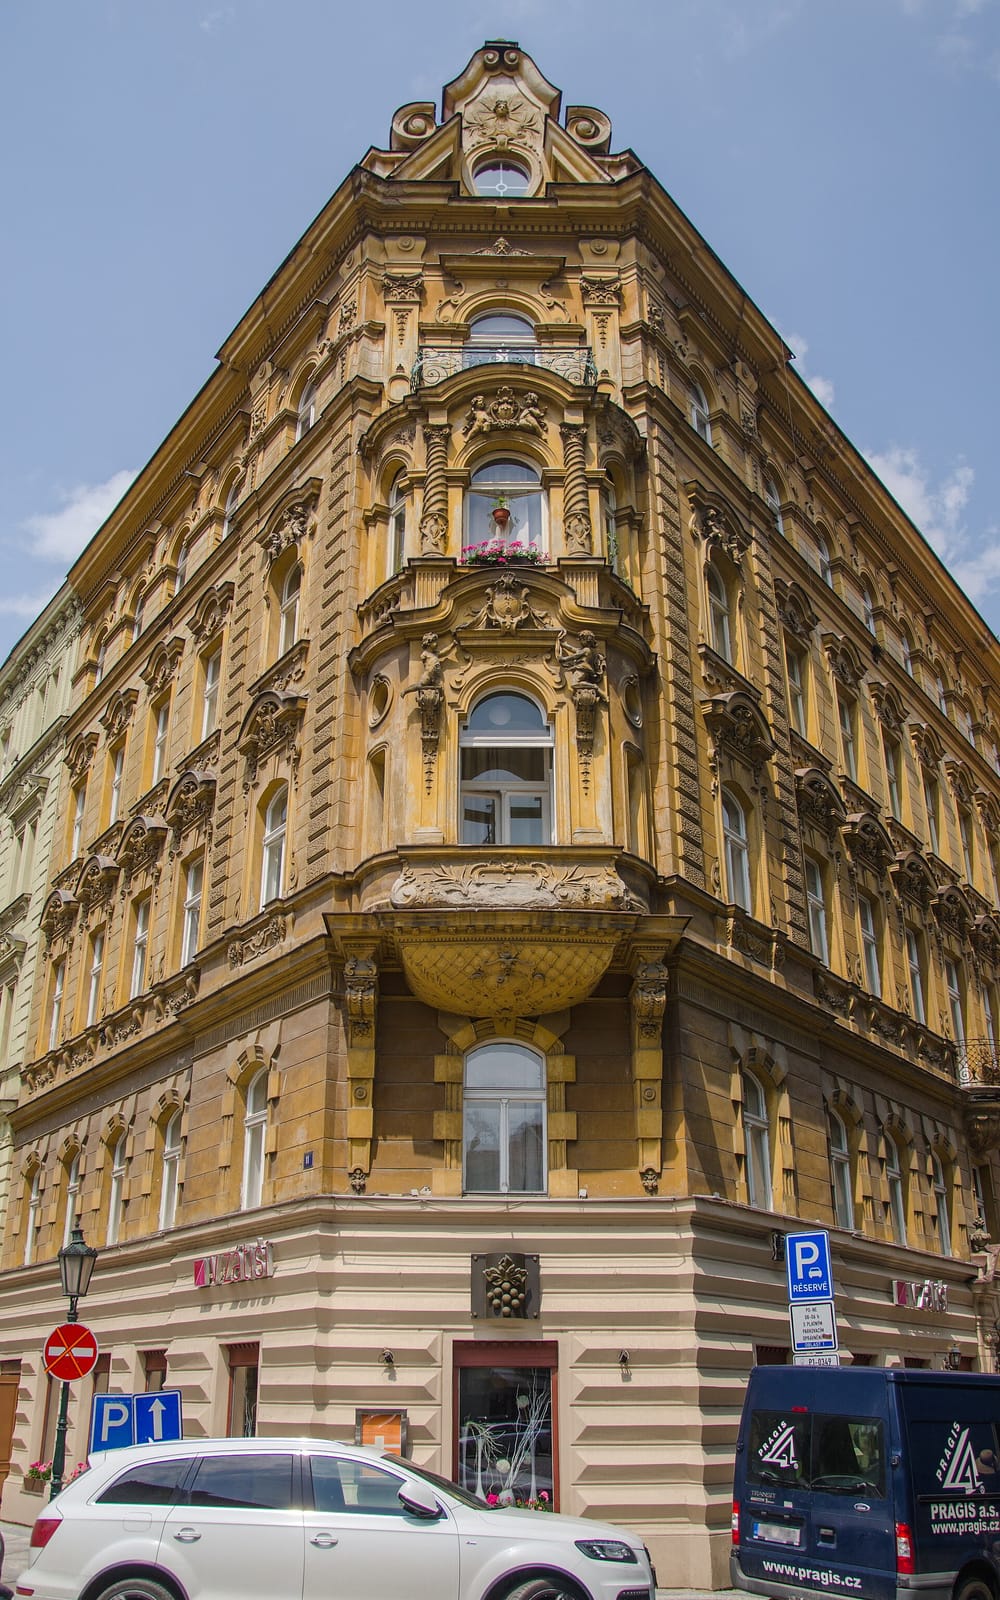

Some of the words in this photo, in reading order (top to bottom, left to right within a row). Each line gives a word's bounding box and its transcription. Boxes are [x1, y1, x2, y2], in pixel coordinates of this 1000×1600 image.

[795, 1241, 819, 1279] P
[792, 1280, 828, 1293] RÉSERVÉ
[101, 1403, 129, 1442] P
[758, 1420, 787, 1457] PRAGIS
[936, 1421, 961, 1482] PRAGIS
[930, 1502, 976, 1520] PRAGIS
[978, 1504, 1000, 1518] a.s.
[931, 1518, 1000, 1535] www.pragis.cz
[762, 1560, 862, 1589] www.pragis.cz
